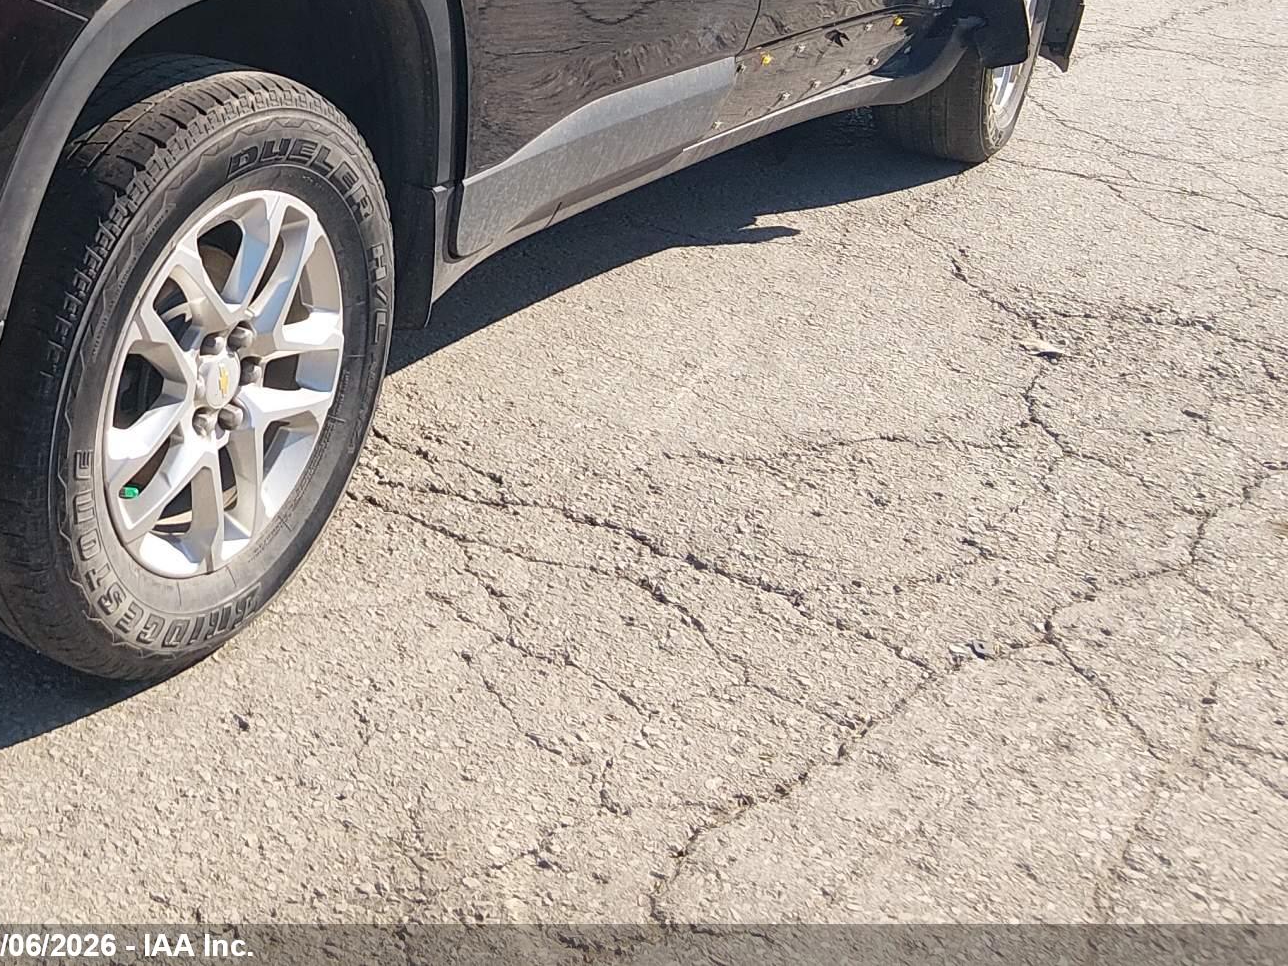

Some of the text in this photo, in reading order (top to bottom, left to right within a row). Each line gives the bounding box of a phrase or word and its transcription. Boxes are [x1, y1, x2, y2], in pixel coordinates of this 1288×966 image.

[226, 137, 389, 344] DUELER H/L
[72, 448, 264, 648] BRIDGESTONE
